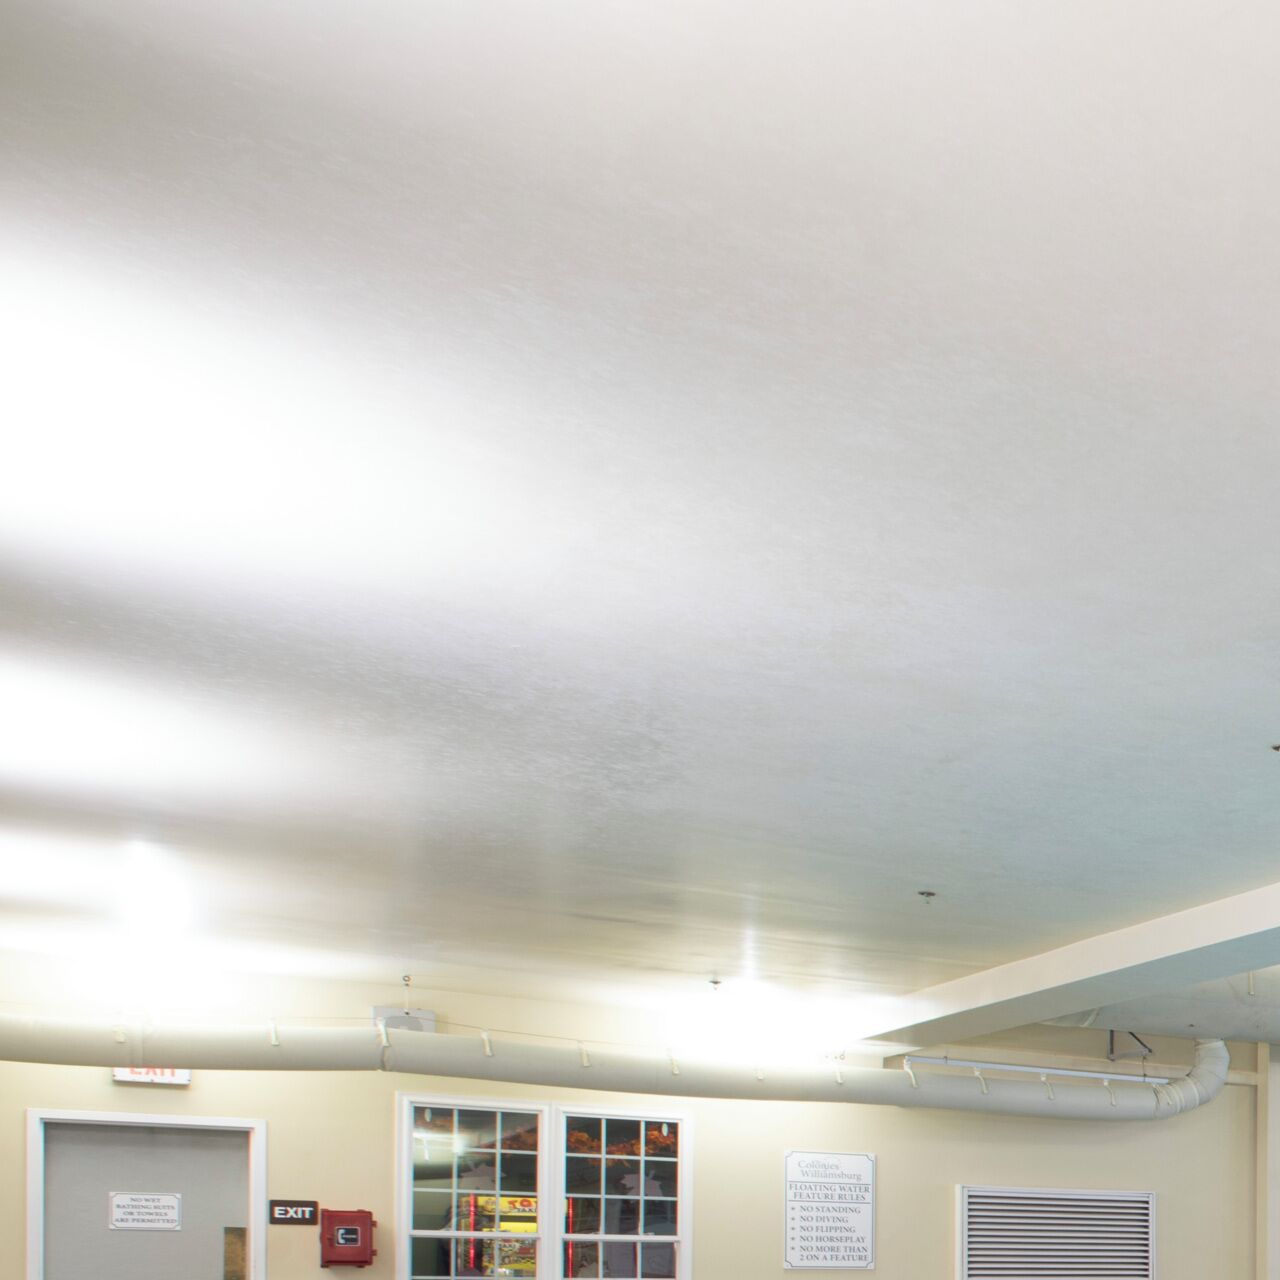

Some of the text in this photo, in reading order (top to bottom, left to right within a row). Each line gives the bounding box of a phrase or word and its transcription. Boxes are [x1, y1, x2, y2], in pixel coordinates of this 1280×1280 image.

[798, 1159, 840, 1170] Colonies
[801, 1169, 863, 1182] Williamsburg
[789, 1183, 870, 1193] FLOATING WATER
[793, 1191, 866, 1201] FEATURE RULES
[273, 1206, 314, 1219] EXIT
[800, 1205, 861, 1214] NO STANDING
[800, 1215, 849, 1223] NO DIVING
[815, 1225, 856, 1233] FLIPPING
[815, 1245, 841, 1253] MORE
[830, 1254, 869, 1262] FEATURE
